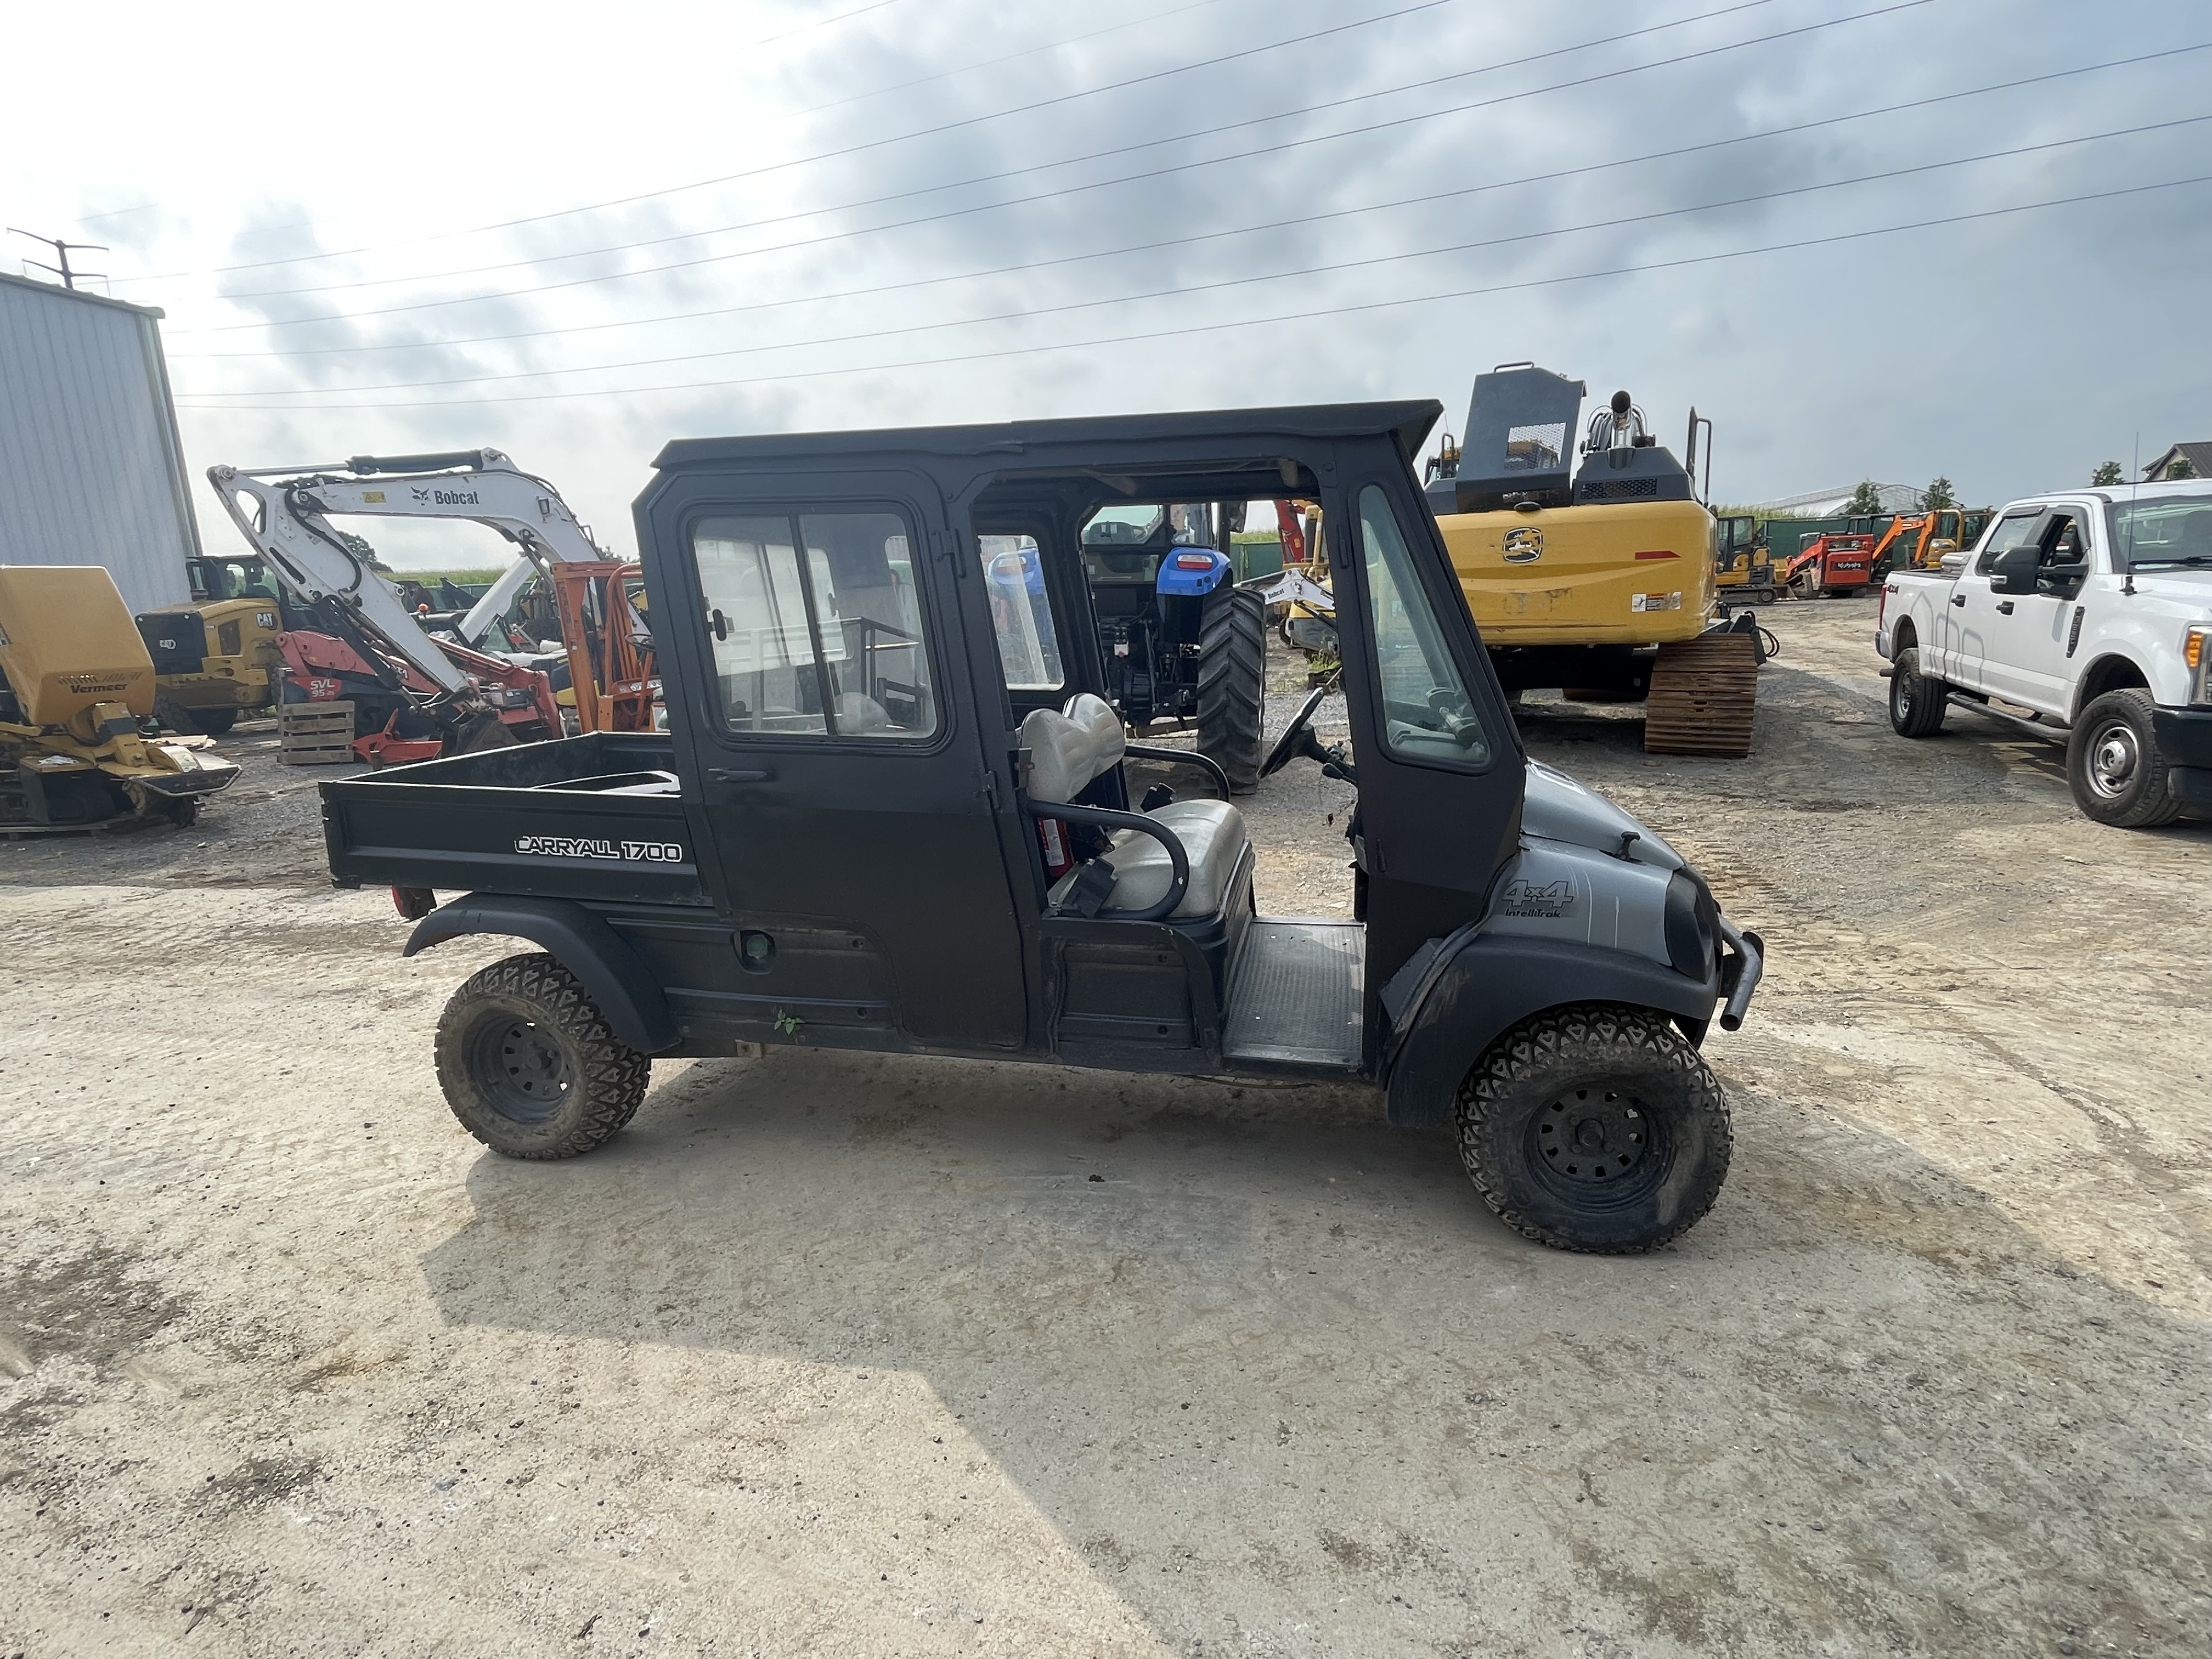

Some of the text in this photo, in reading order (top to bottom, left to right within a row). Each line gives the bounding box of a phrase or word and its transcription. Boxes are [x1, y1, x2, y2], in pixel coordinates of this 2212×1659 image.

[433, 490, 479, 505] Bobcat
[256, 613, 273, 627] CAT
[70, 684, 127, 693] Vermeer
[310, 679, 335, 690] SVL
[514, 836, 683, 862] CARRYALL 1700
[1505, 908, 1561, 918] IntelliTrak
